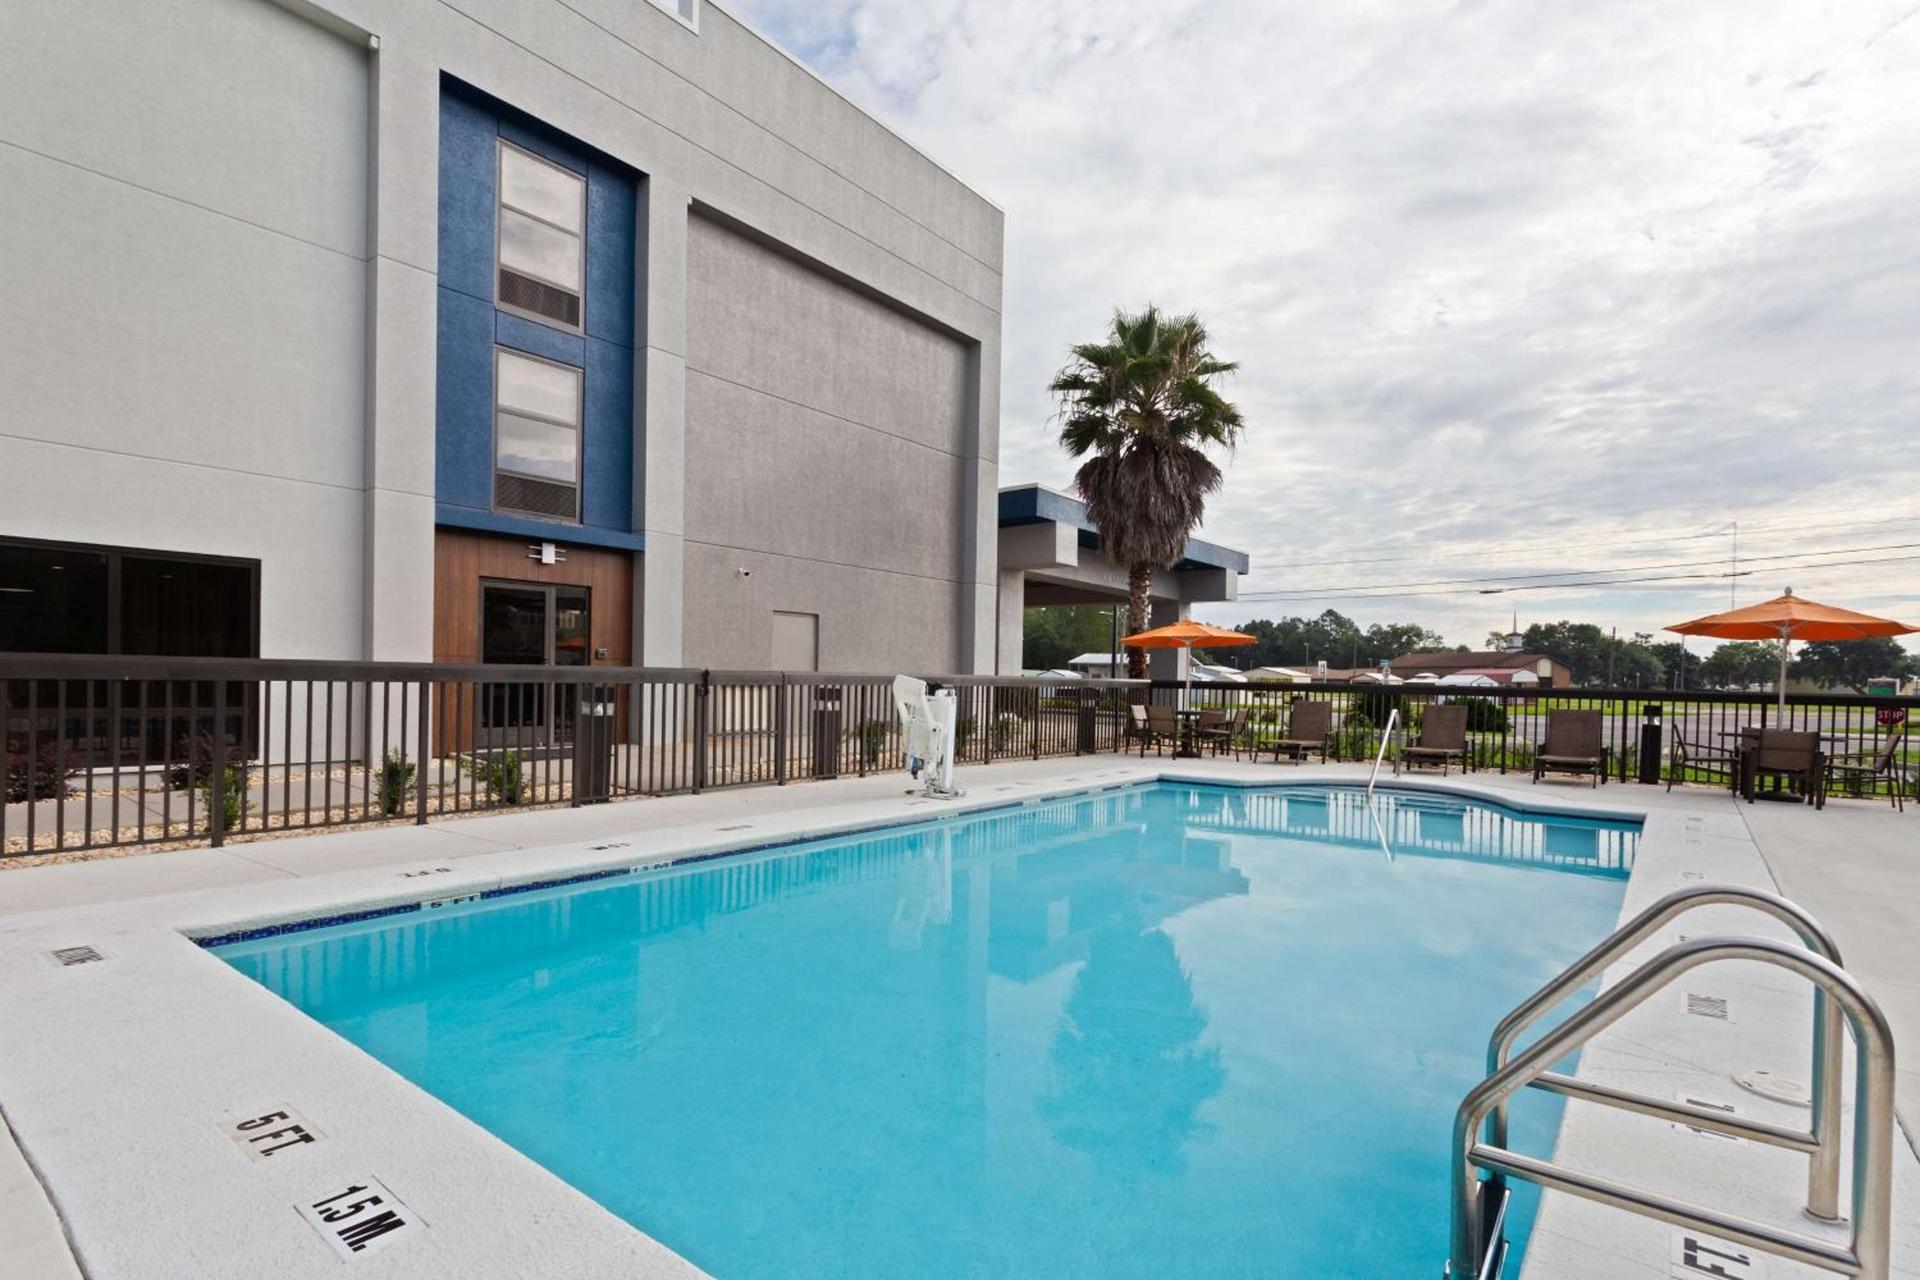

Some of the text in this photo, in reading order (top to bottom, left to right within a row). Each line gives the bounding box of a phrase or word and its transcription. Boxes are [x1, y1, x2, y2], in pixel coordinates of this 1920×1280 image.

[237, 1111, 315, 1157] 5 FT.
[312, 1185, 384, 1223] 1.5
